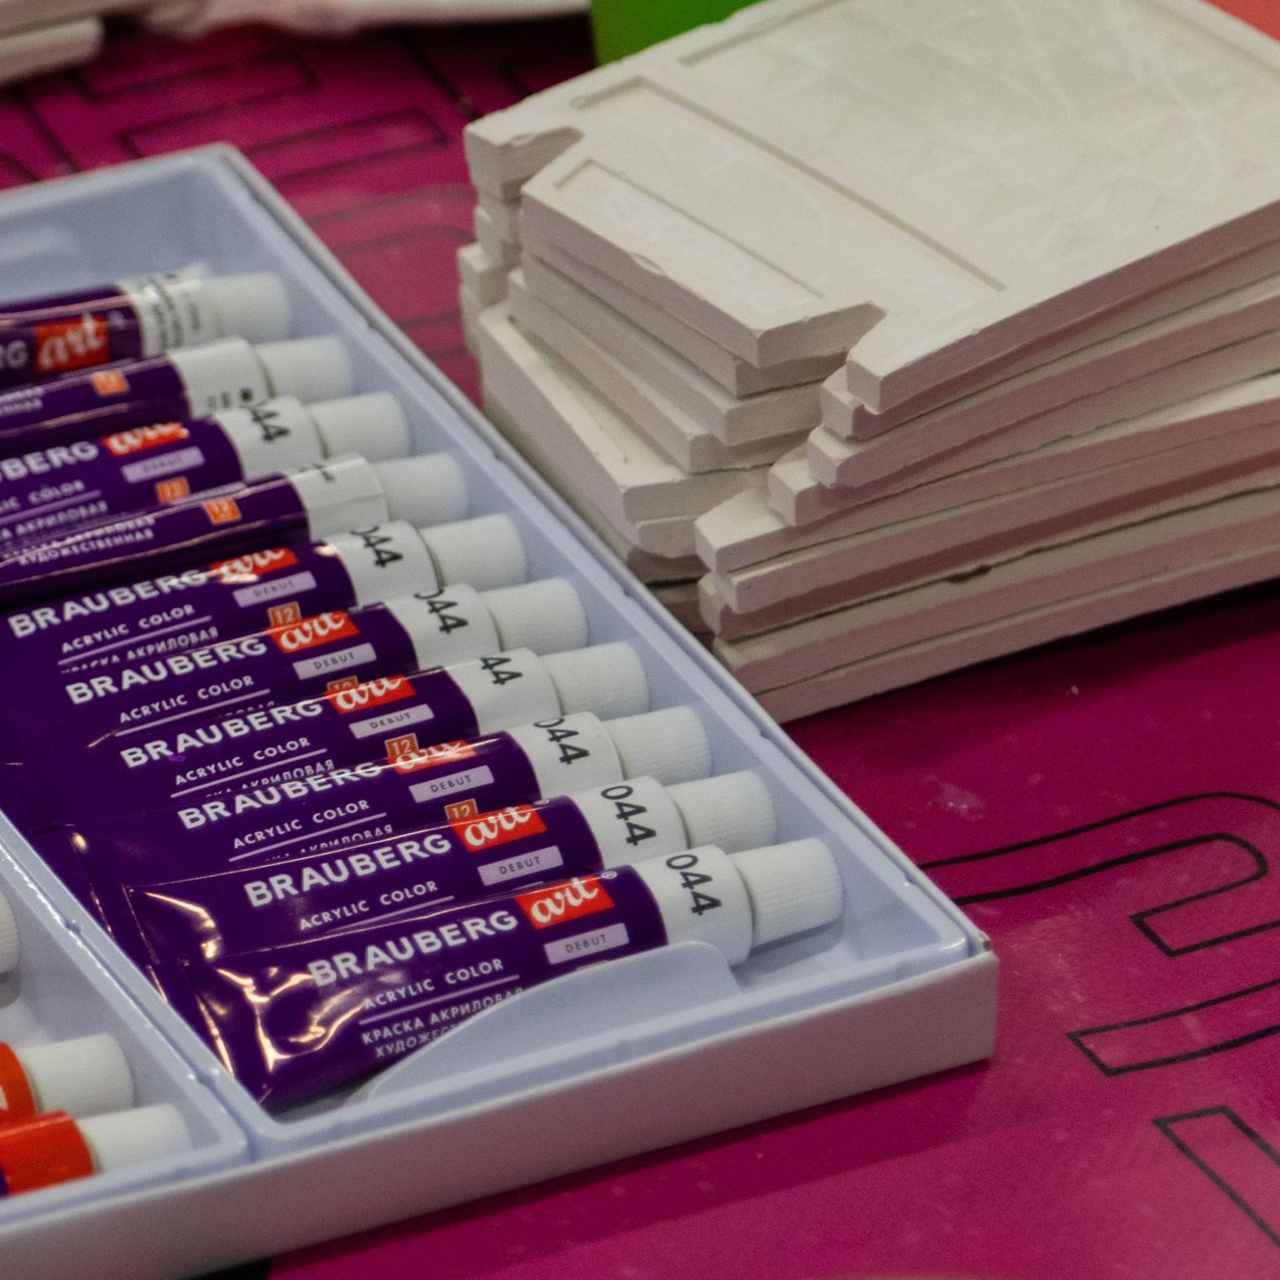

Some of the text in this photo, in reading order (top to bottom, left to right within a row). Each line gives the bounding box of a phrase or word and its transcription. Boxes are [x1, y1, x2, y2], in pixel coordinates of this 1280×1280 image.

[242, 402, 291, 442] 44
[28, 480, 85, 505] COLOR
[350, 526, 404, 568] 44
[8, 569, 208, 638] BRAUBERG
[276, 606, 295, 624] 12
[61, 604, 195, 654] ACRYLIC COLOR
[126, 627, 219, 661] АКРИЛОВАЯ
[66, 612, 346, 705] BRAUBERG art
[313, 652, 355, 671] DEBUT
[119, 694, 188, 724] ACRYLIC
[197, 675, 254, 700] COLOR
[370, 713, 412, 730] DEBUT
[120, 699, 323, 768] BRAUBERG
[394, 739, 412, 756] 12
[175, 737, 311, 786] ACRYLIC COLOR
[430, 775, 472, 793] DEBUT
[177, 761, 383, 829] BRAUBERG
[600, 784, 657, 847] 044
[232, 799, 371, 850] ACRYLIC COLOR
[244, 806, 531, 908] BRAUBERG art
[499, 856, 541, 876] DEBUT
[298, 880, 439, 931] ACRYLIC COLOR
[665, 853, 723, 917] 044
[307, 876, 599, 987] BRAUBERG art
[564, 933, 608, 954] DEBUT
[363, 957, 505, 1011] ACRYLIC COLOR
[362, 1018, 424, 1045] КРАСКА
